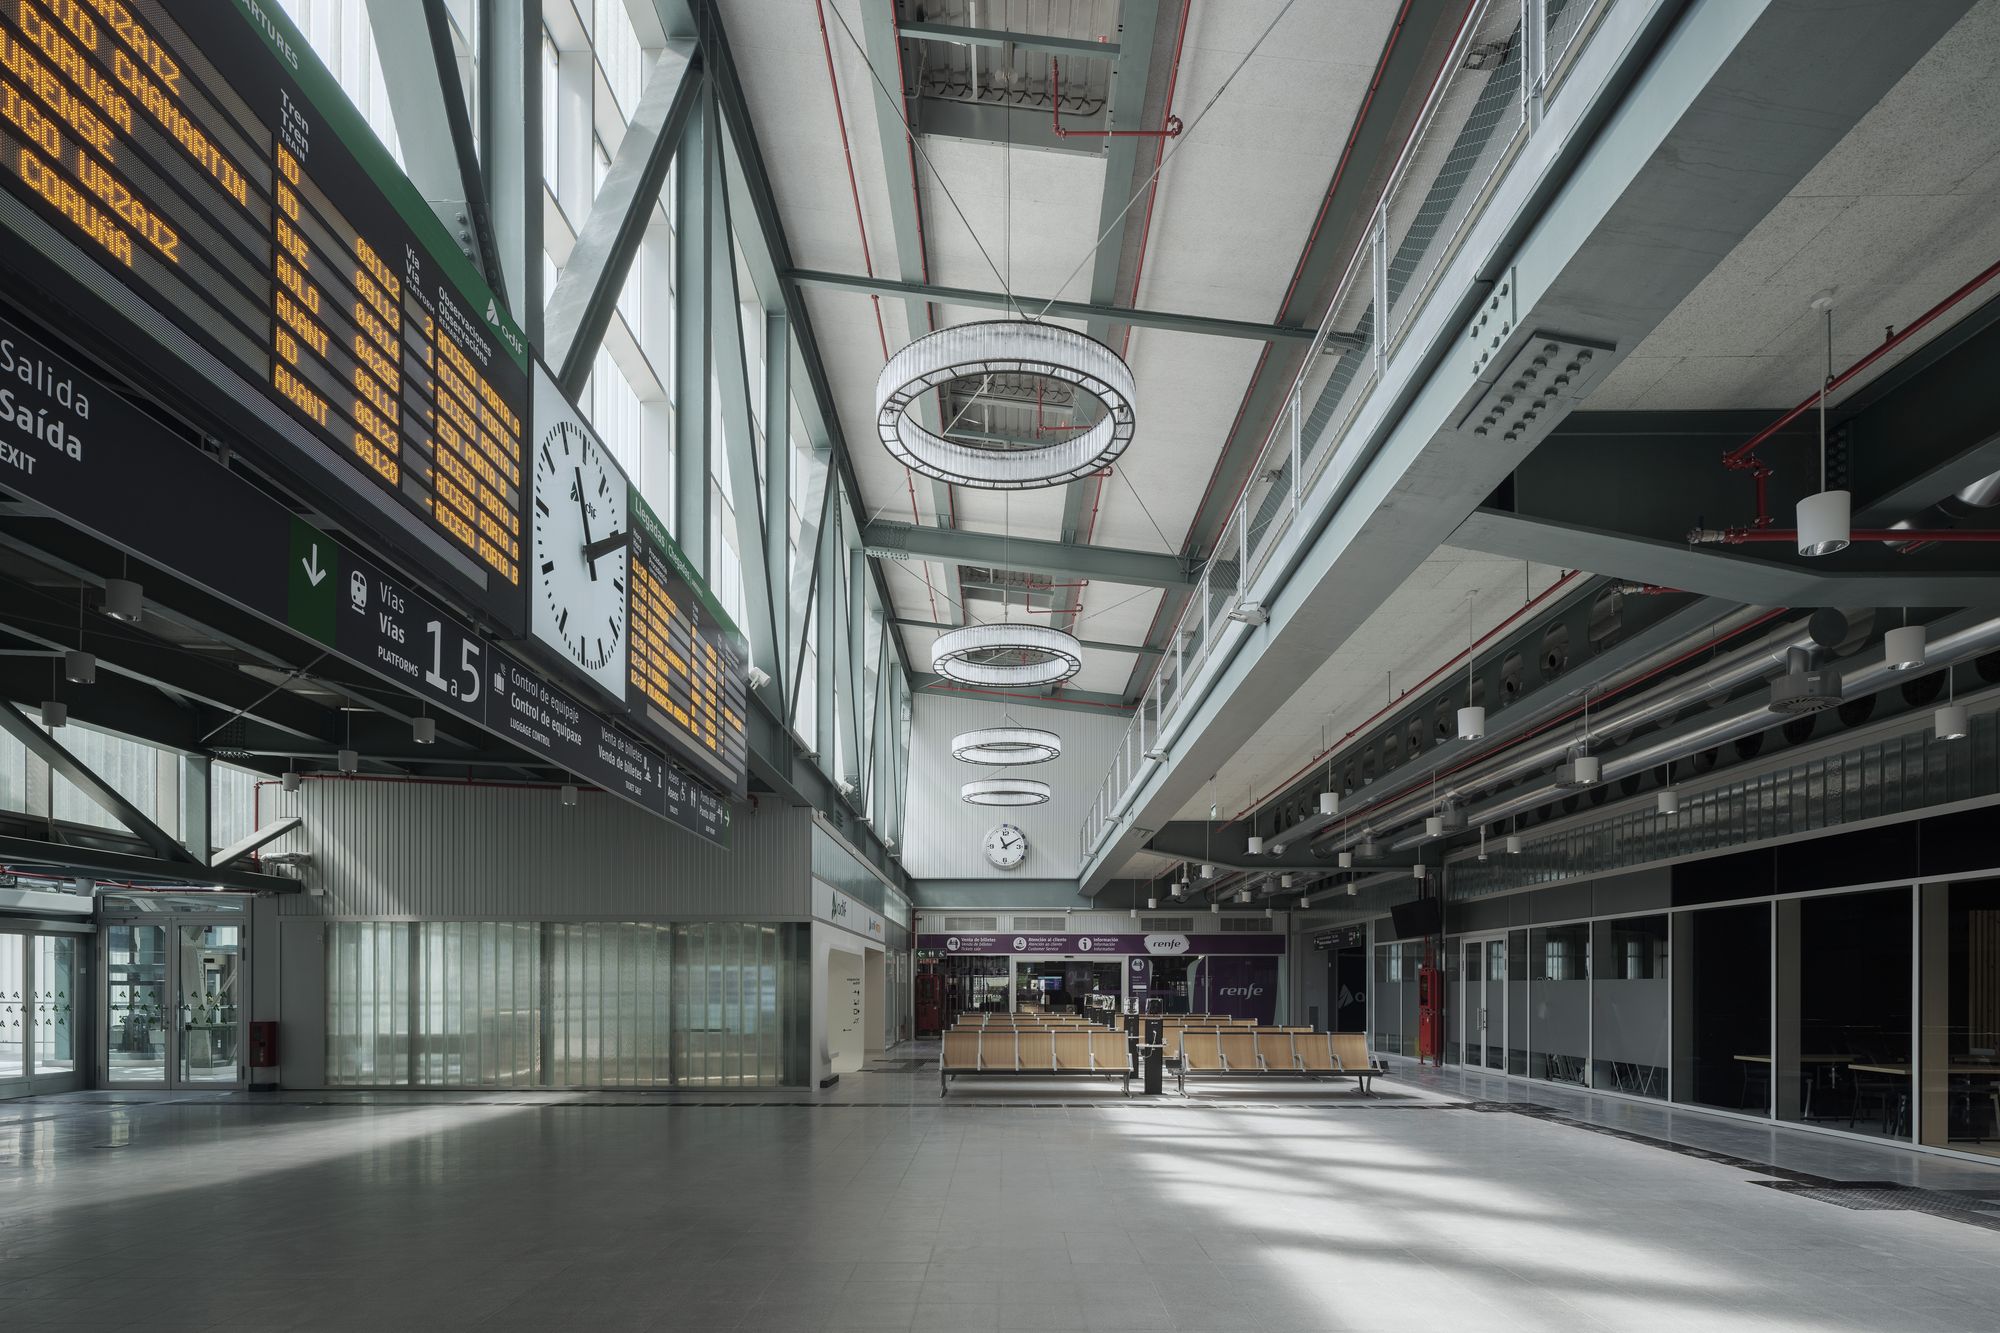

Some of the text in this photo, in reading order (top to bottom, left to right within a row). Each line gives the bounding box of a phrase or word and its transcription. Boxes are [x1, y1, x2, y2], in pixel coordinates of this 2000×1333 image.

[20, 0, 132, 135] CORUÑA
[115, 46, 247, 208] CHAMARTIN
[281, 88, 309, 134] Tren
[281, 107, 309, 154] Tren
[277, 142, 299, 186] MD
[280, 126, 305, 162] TRAIN
[20, 148, 132, 268] CORUÑA
[79, 147, 180, 264] URZAIZ
[277, 178, 299, 222] MD
[277, 217, 309, 271] AVE
[357, 237, 400, 302] 09112
[356, 270, 400, 332] 09113
[406, 275, 435, 314] PLATFORM
[439, 286, 492, 358] Observaciones
[276, 326, 298, 366] MD
[277, 291, 328, 358] AVANT
[356, 303, 399, 363] 04314
[425, 316, 434, 341] 2
[439, 316, 463, 348] REMARKS
[439, 301, 488, 367] Observacións
[501, 325, 523, 355] adif
[0, 339, 90, 420] Salida
[355, 335, 399, 394] 04295
[426, 346, 434, 370] 1
[438, 328, 476, 388] ACCESO
[482, 378, 510, 426] PORTA
[275, 363, 328, 427] AVANT
[355, 367, 399, 427] 09111
[438, 356, 476, 415] ACCESO
[482, 404, 510, 452] PORTA
[0, 388, 82, 462] Saída
[355, 400, 399, 457] 09123
[437, 385, 476, 440] ACCESO
[481, 430, 509, 477] PORTA
[437, 414, 460, 453] ESO
[465, 441, 496, 488] PORTA
[0, 440, 36, 475] EXIT
[355, 432, 399, 488] 09120
[436, 443, 475, 495] ACCESO
[480, 483, 509, 527] PORTA
[436, 471, 475, 521] ACCESO
[480, 509, 509, 553] PORTA
[584, 501, 597, 520] dif
[635, 497, 666, 548] Llegadas
[435, 500, 475, 549] ACCESO
[479, 535, 509, 578] PORTA
[380, 581, 405, 614] Vías
[379, 611, 405, 644] Vías
[378, 645, 419, 677] PLATFORMS
[425, 620, 480, 702] 1 a 5
[511, 668, 579, 724] Control de equipaje
[511, 692, 582, 746] Control de equipaxe
[510, 717, 551, 747] LUGGAGE CONTROL
[601, 726, 643, 763] Venta de billetes
[598, 744, 642, 780] Venda de billetes
[668, 770, 679, 786] Aseos
[668, 786, 679, 801] Aseos
[1153, 938, 1181, 950] renfe
[1219, 983, 1263, 1000] renfe
